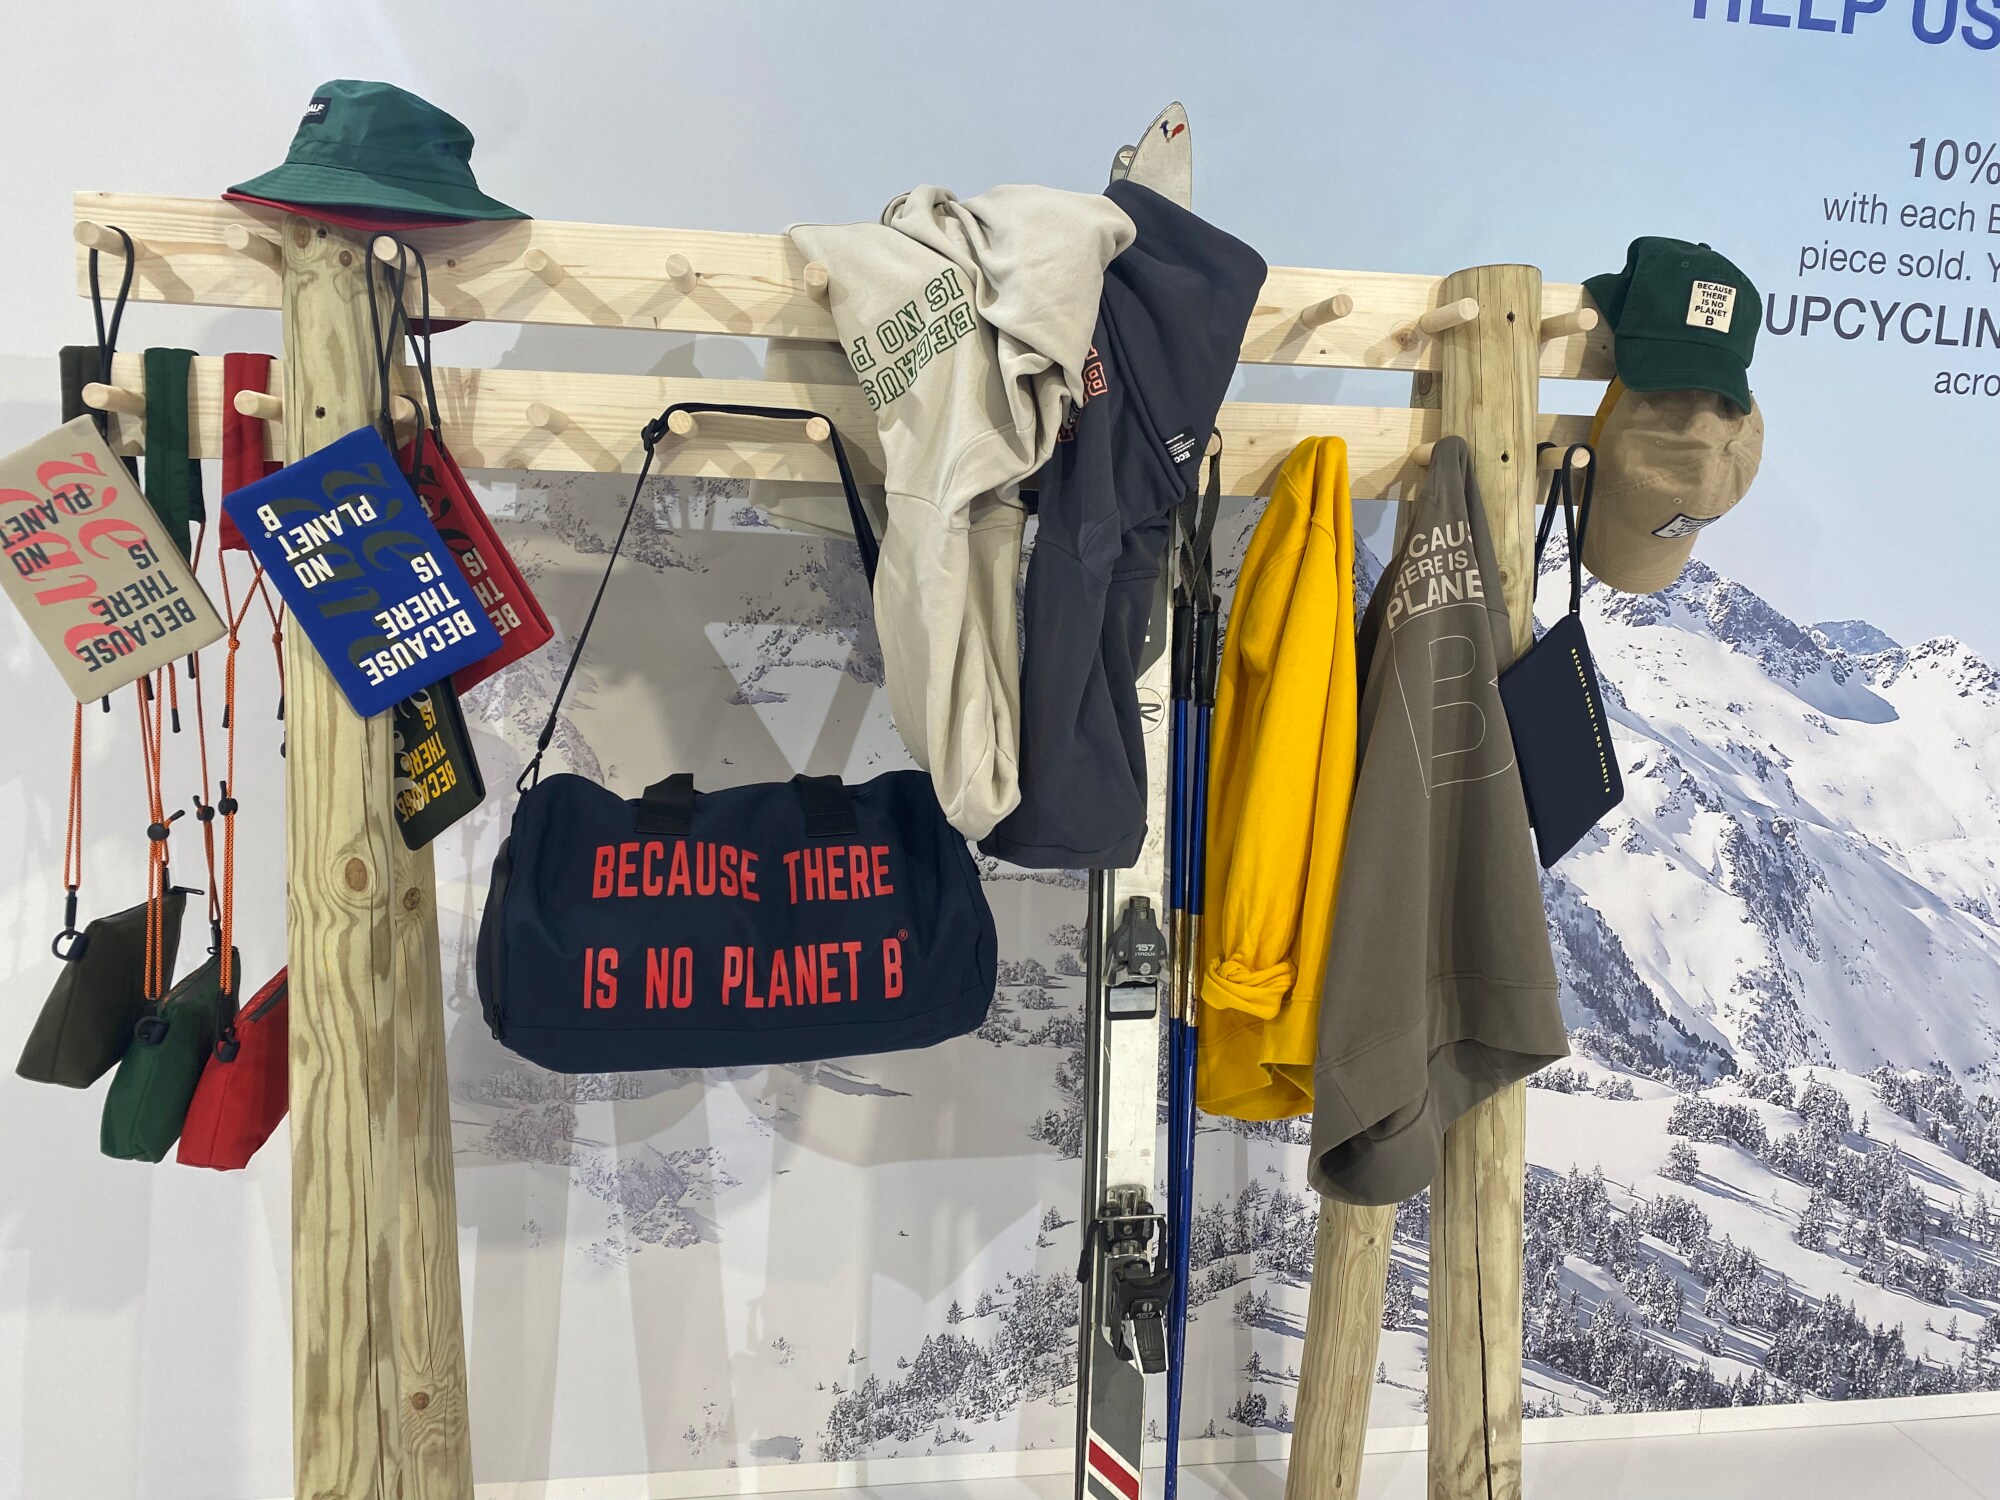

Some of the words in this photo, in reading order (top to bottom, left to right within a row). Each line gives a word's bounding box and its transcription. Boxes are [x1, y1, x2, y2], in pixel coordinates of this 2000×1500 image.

[1911, 0, 2000, 50] US
[1909, 137, 2000, 185] 10%
[1823, 192, 1888, 225] with
[1900, 200, 1976, 232] each
[1799, 240, 1887, 277] piece
[1897, 249, 1971, 281] sold.
[925, 268, 964, 312] IS
[1697, 283, 1733, 295] BECAUSE
[1702, 290, 1727, 302] THERE
[1711, 300, 1724, 308] NO
[876, 300, 926, 354] NO
[1695, 305, 1727, 318] PLANET
[1705, 315, 1714, 325] B
[1934, 371, 2000, 397] acro
[0, 484, 93, 550] PLANET
[277, 495, 377, 562] PLANET
[11, 543, 51, 576] NO
[127, 539, 160, 570] IS
[294, 553, 335, 589] NO
[410, 551, 443, 583] IS
[462, 547, 488, 577] IS
[1448, 550, 1469, 571] IS
[92, 569, 178, 627] THERE
[374, 582, 461, 640] THERE
[76, 597, 197, 673] BECAUSE
[359, 609, 477, 686] BECAUSE
[1571, 648, 1587, 688] BECAUSE
[1584, 691, 1595, 719] THERE
[1596, 735, 1603, 748] NO
[1600, 751, 1609, 783] PLANET
[592, 840, 760, 902] BECAUSE
[783, 845, 894, 905] THERE
[583, 947, 619, 1009] IS
[645, 947, 694, 1009] NO
[721, 941, 862, 1008] PLANET
